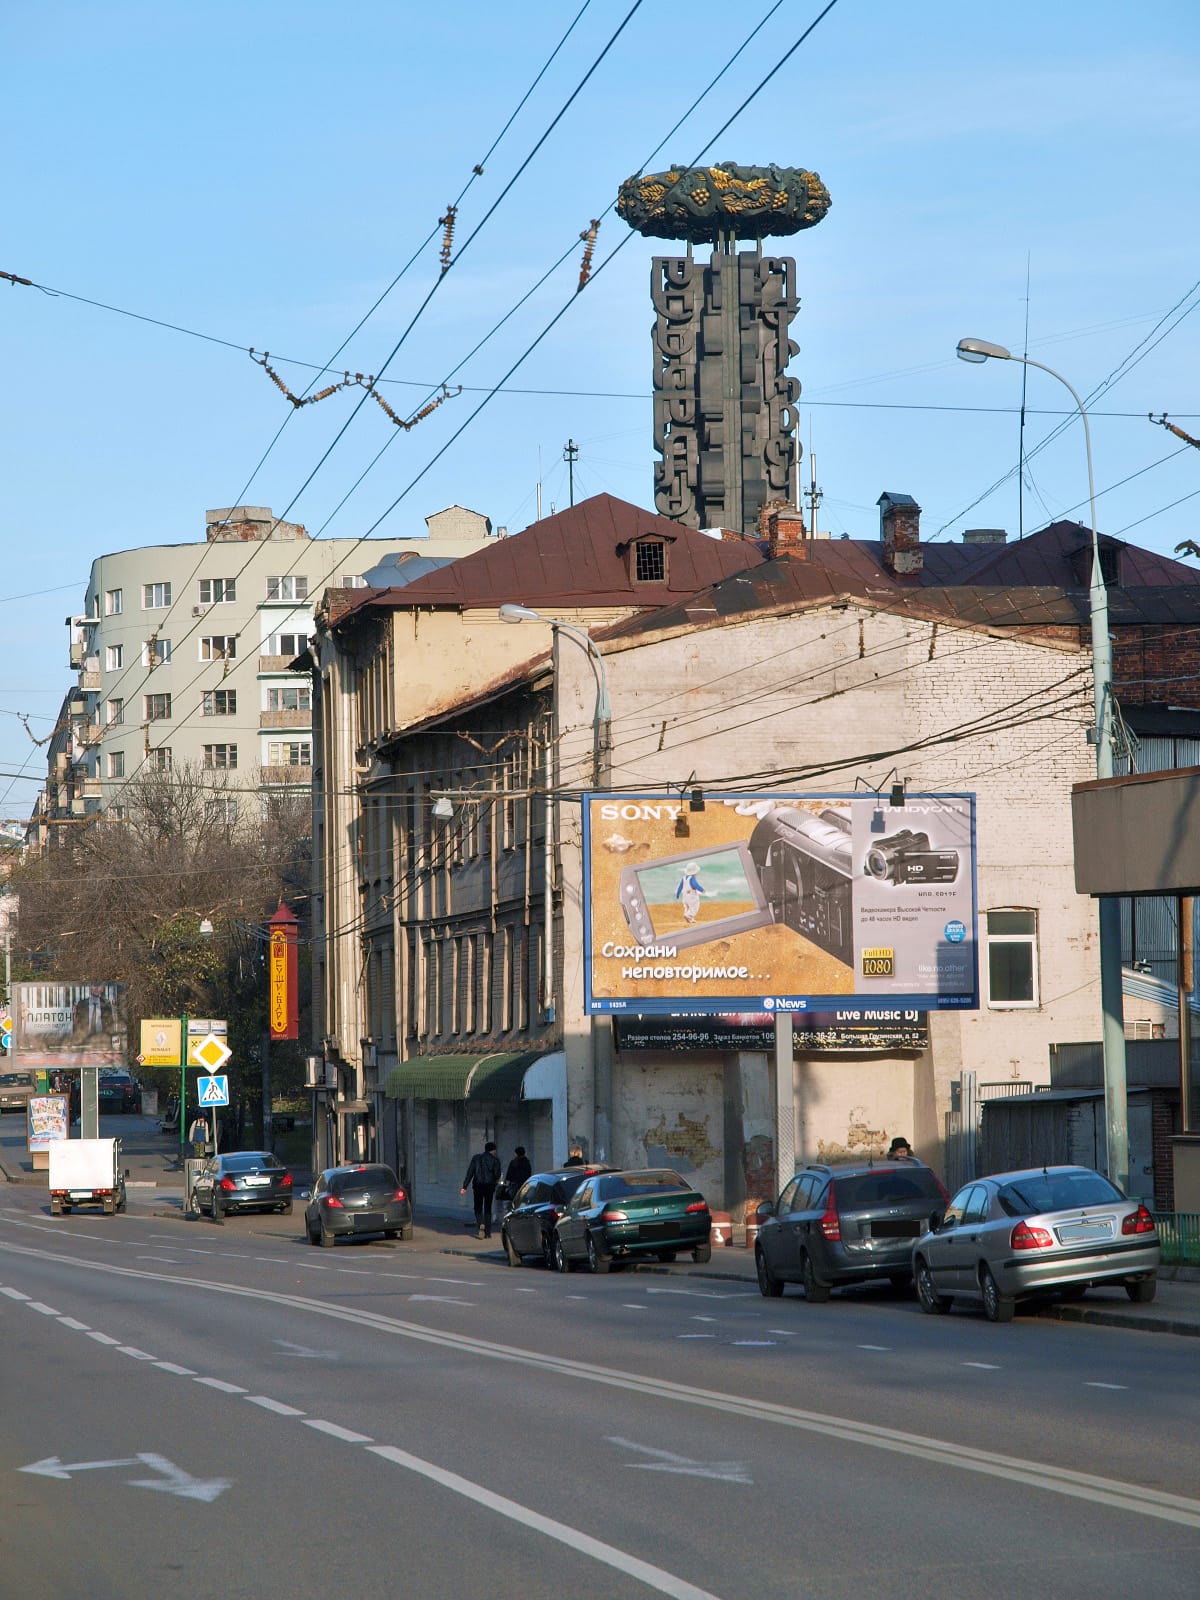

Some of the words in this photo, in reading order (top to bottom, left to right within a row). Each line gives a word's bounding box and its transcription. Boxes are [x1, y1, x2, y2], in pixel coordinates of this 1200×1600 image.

[601, 804, 682, 820] SONY
[601, 942, 678, 962] Сохрани
[863, 960, 891, 974] 1080
